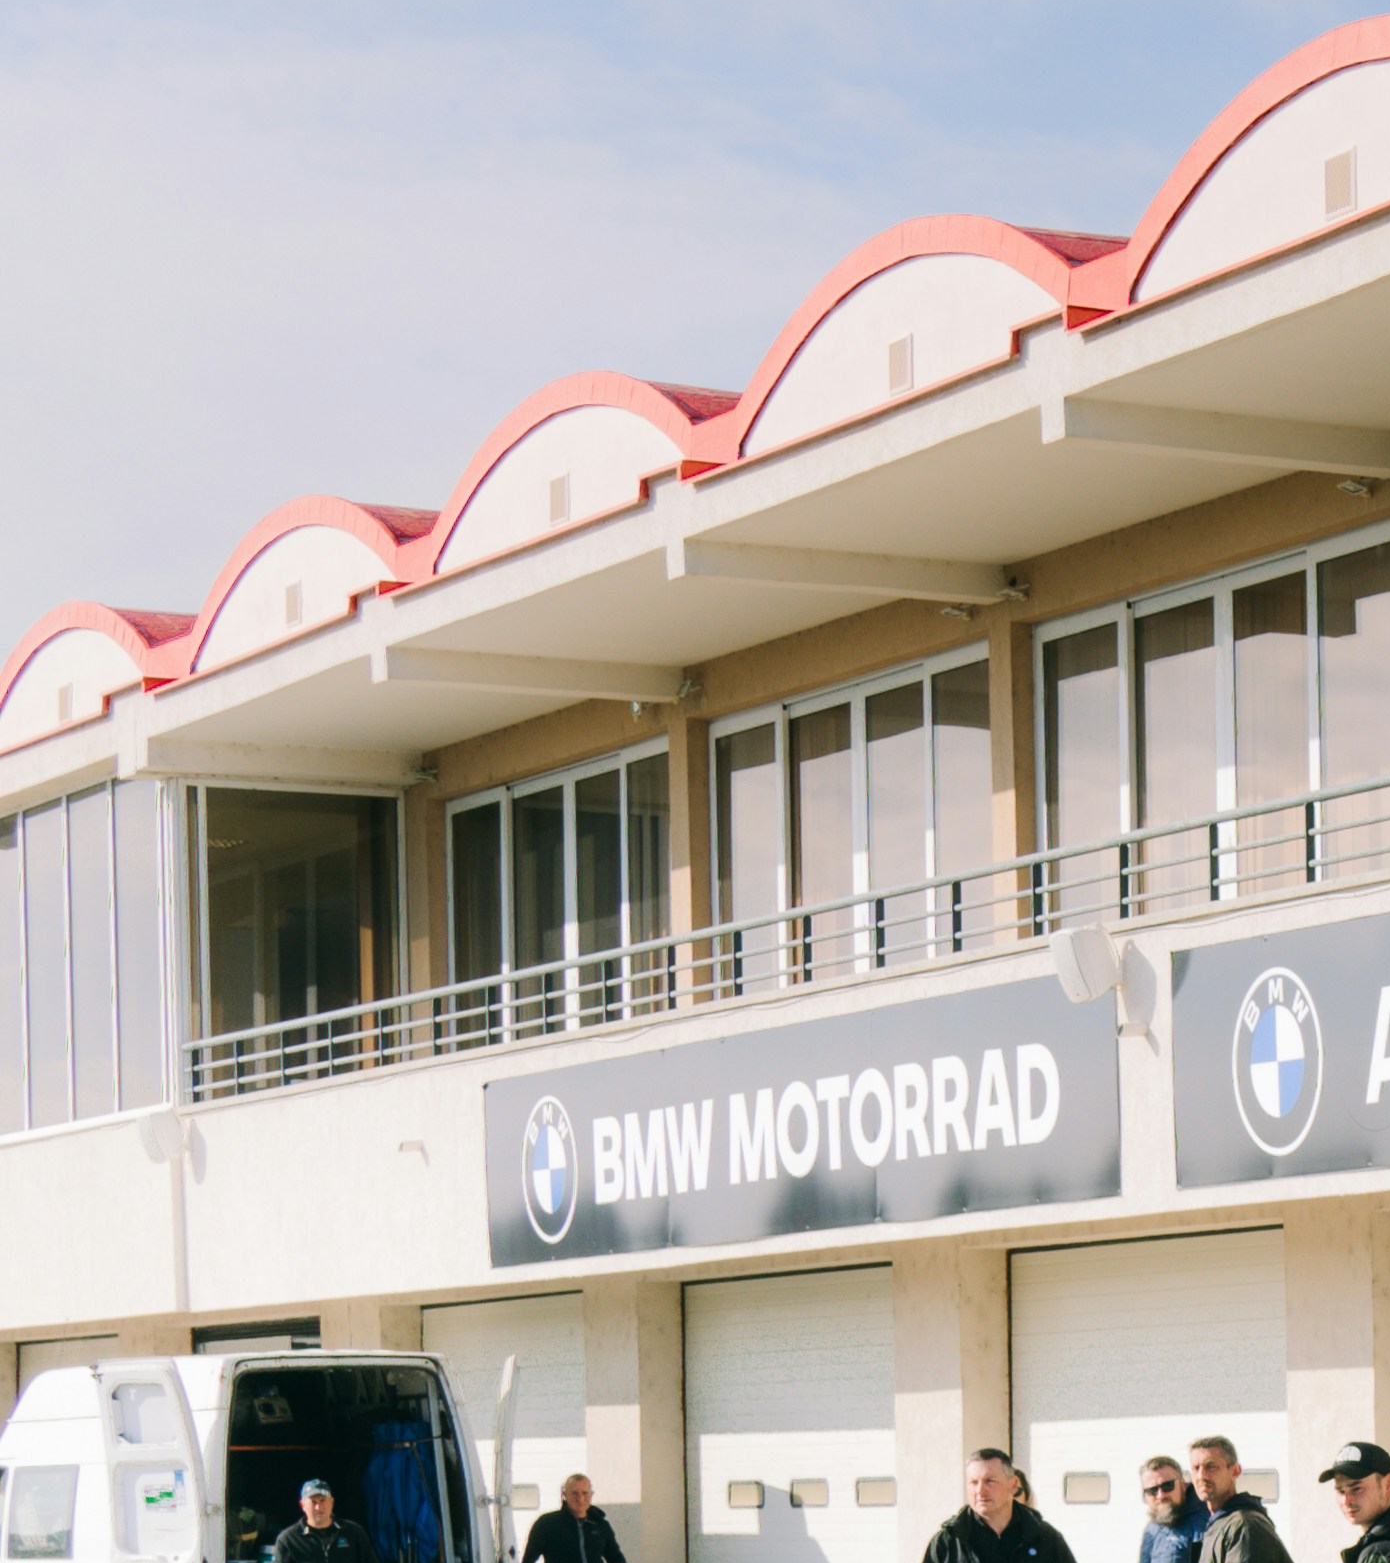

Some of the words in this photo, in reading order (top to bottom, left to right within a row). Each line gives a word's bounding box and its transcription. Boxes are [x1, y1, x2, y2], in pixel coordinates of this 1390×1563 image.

[1243, 976, 1310, 1033] BMW
[593, 1098, 714, 1205] BMW
[729, 1043, 1060, 1186] MOTORRAD
